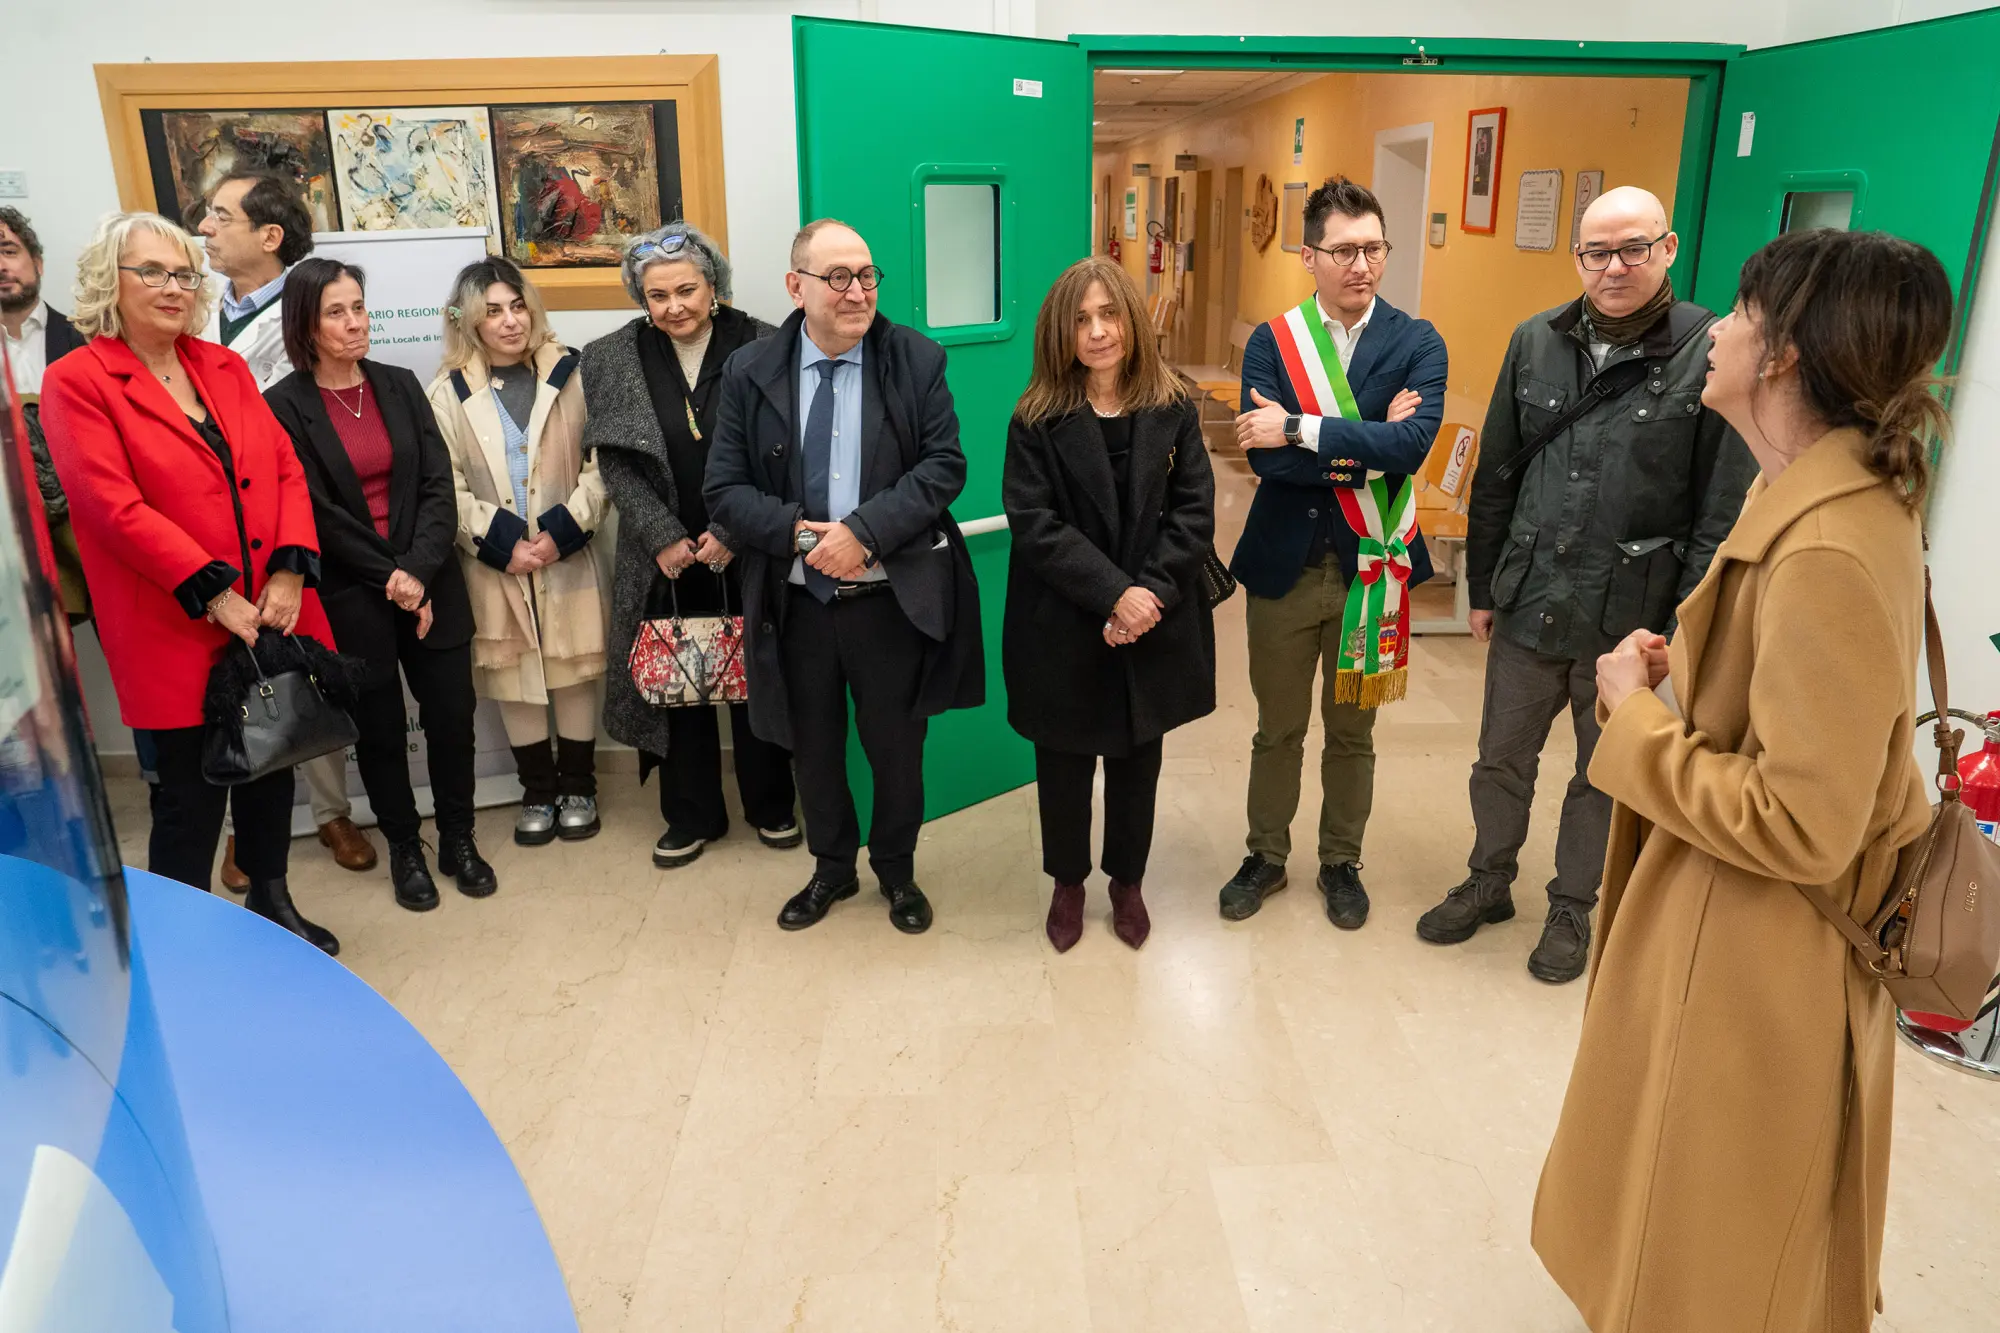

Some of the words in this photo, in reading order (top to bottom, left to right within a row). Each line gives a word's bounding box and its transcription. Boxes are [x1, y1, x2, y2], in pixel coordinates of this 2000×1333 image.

[368, 310, 394, 320] ARIO
[368, 323, 385, 333] NA
[393, 336, 421, 344] Locale
[433, 334, 442, 342] In
